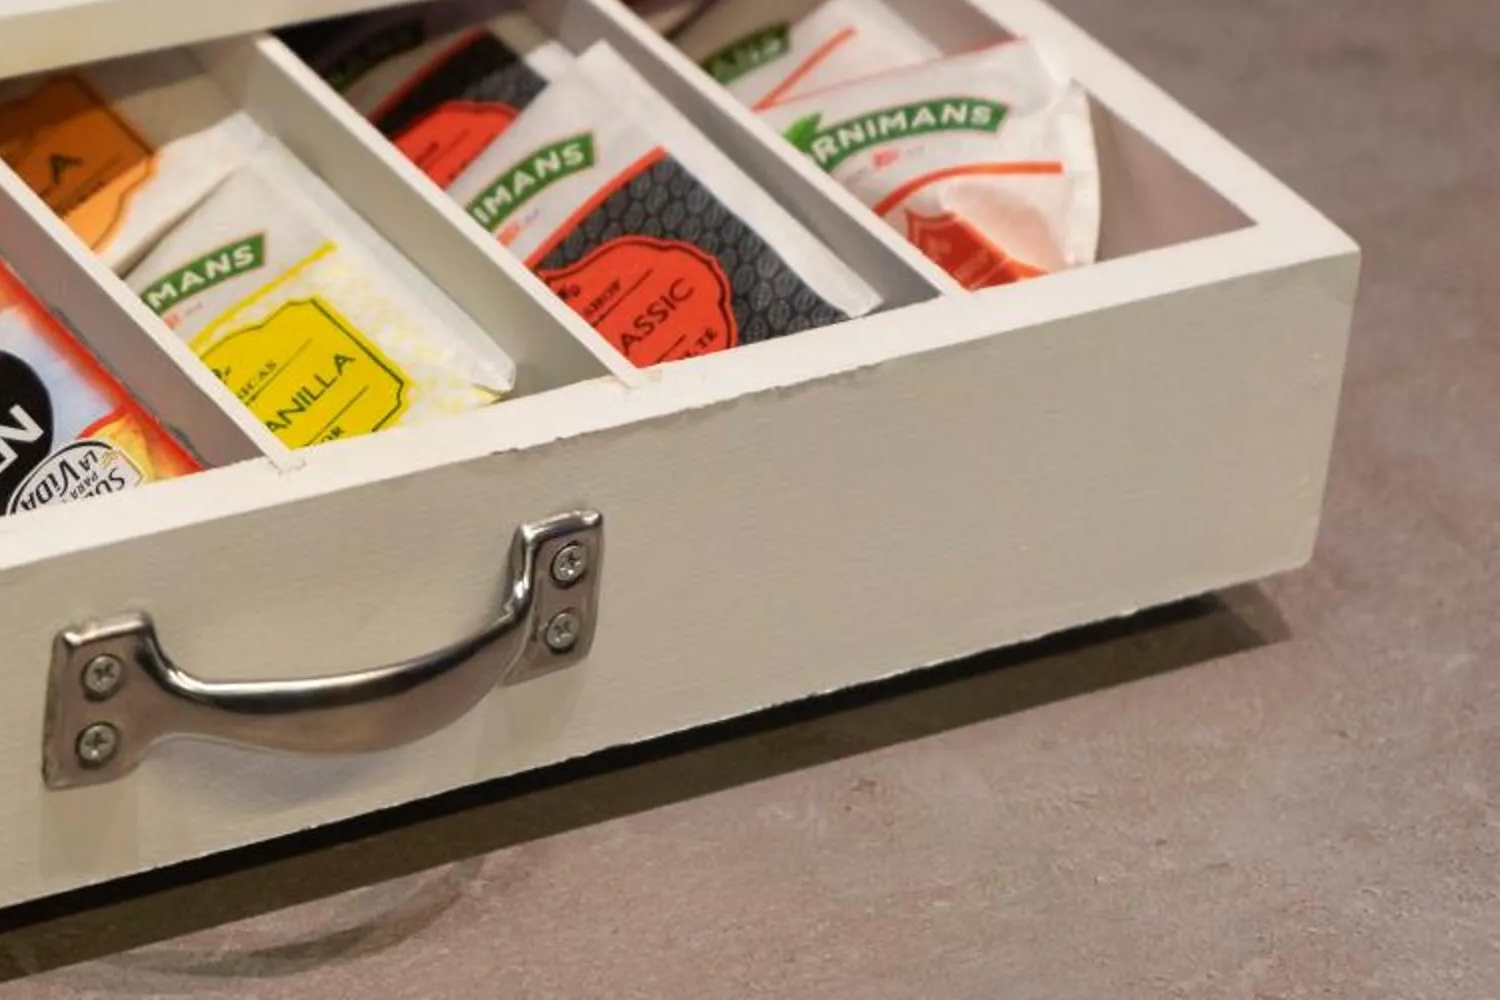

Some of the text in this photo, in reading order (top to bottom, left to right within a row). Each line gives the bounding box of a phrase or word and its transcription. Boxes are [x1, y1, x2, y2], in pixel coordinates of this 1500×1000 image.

[811, 103, 992, 163] RNIMANS
[473, 142, 585, 223] IMANS
[146, 244, 255, 309] MANS
[619, 277, 696, 356] ASSIC
[264, 353, 357, 433] ANILLA
[78, 449, 99, 472] LA
